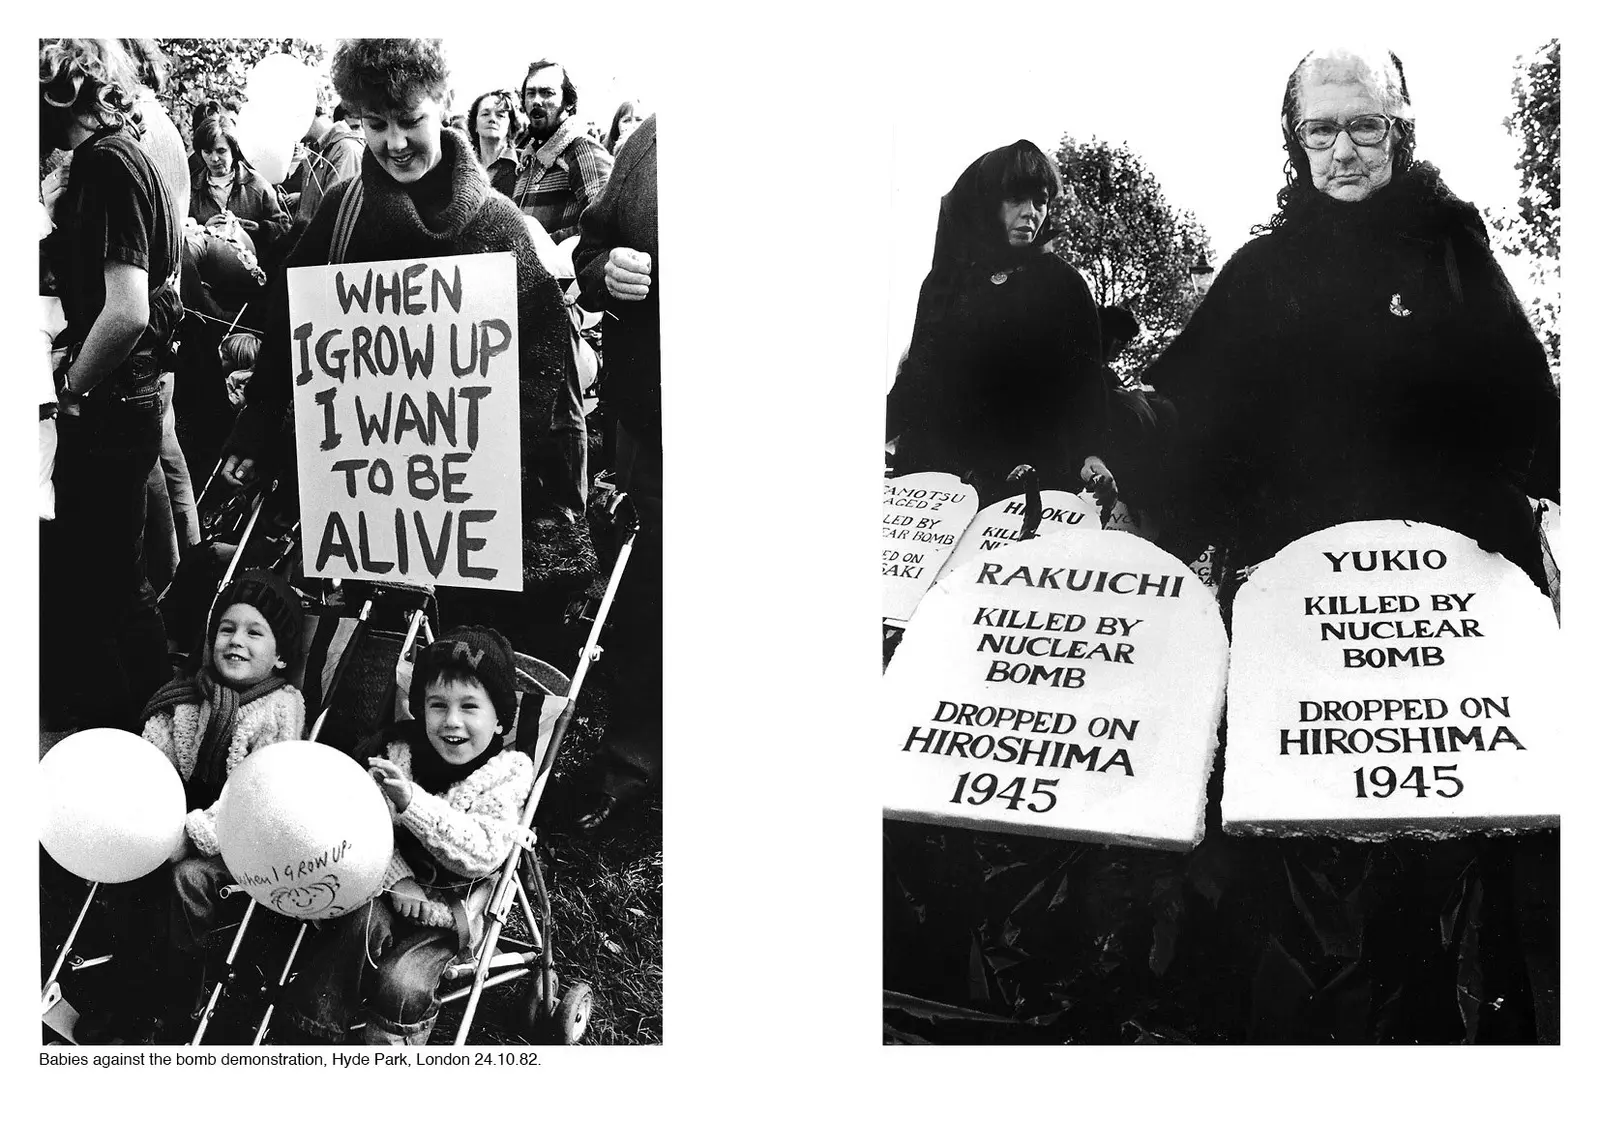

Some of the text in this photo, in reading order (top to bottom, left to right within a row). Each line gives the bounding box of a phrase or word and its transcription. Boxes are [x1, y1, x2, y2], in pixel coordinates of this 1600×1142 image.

[336, 263, 463, 316] WHEN
[294, 318, 513, 387] I GROW UP
[315, 386, 492, 452] I WANT
[331, 452, 474, 504] TO BE
[930, 502, 943, 511] 2
[912, 531, 955, 545] BOMB
[915, 518, 942, 529] BY
[316, 507, 499, 581] ALIVE
[902, 552, 925, 564] ON
[1322, 549, 1447, 573] YUKIO
[975, 562, 1185, 598] RAKUICHI
[1304, 593, 1477, 616] KILLED BY
[973, 607, 1144, 637] KILLED BY
[1321, 619, 1485, 641] NUCLEAR
[976, 633, 1135, 665] NUCLEAR
[1342, 646, 1445, 669] BOMB
[985, 660, 1086, 689] BOMB
[931, 701, 1140, 741] DROPPED ON
[1299, 696, 1511, 722] DROPPED ON
[901, 726, 1135, 777] HIROSHIMA
[1279, 725, 1528, 755] HIROSHIMA
[949, 771, 1060, 814] 1945
[1353, 764, 1464, 798] 1945
